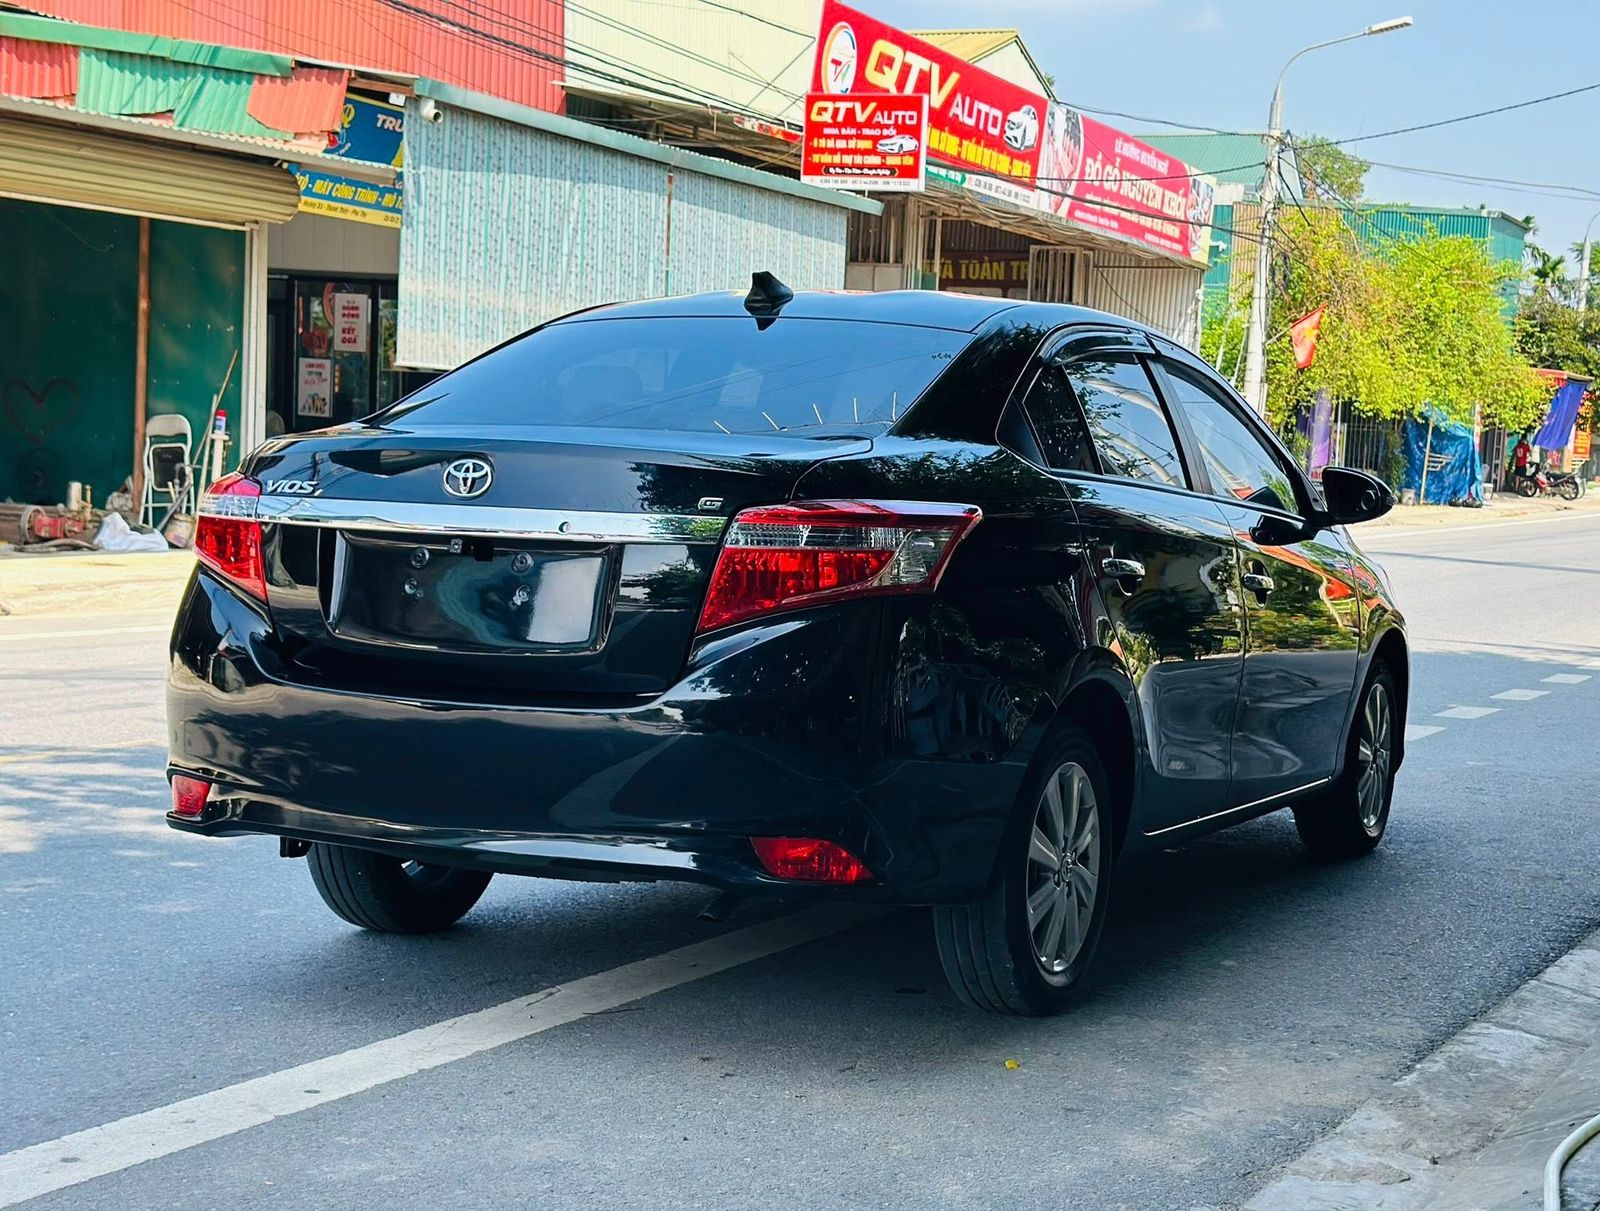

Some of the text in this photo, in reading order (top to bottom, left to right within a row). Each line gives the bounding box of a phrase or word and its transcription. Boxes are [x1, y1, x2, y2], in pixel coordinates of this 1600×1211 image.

[864, 38, 1003, 138] QTV AUTO
[810, 100, 918, 125] QTV AUTO
[265, 479, 319, 494] VIOS
[697, 496, 724, 510] G
